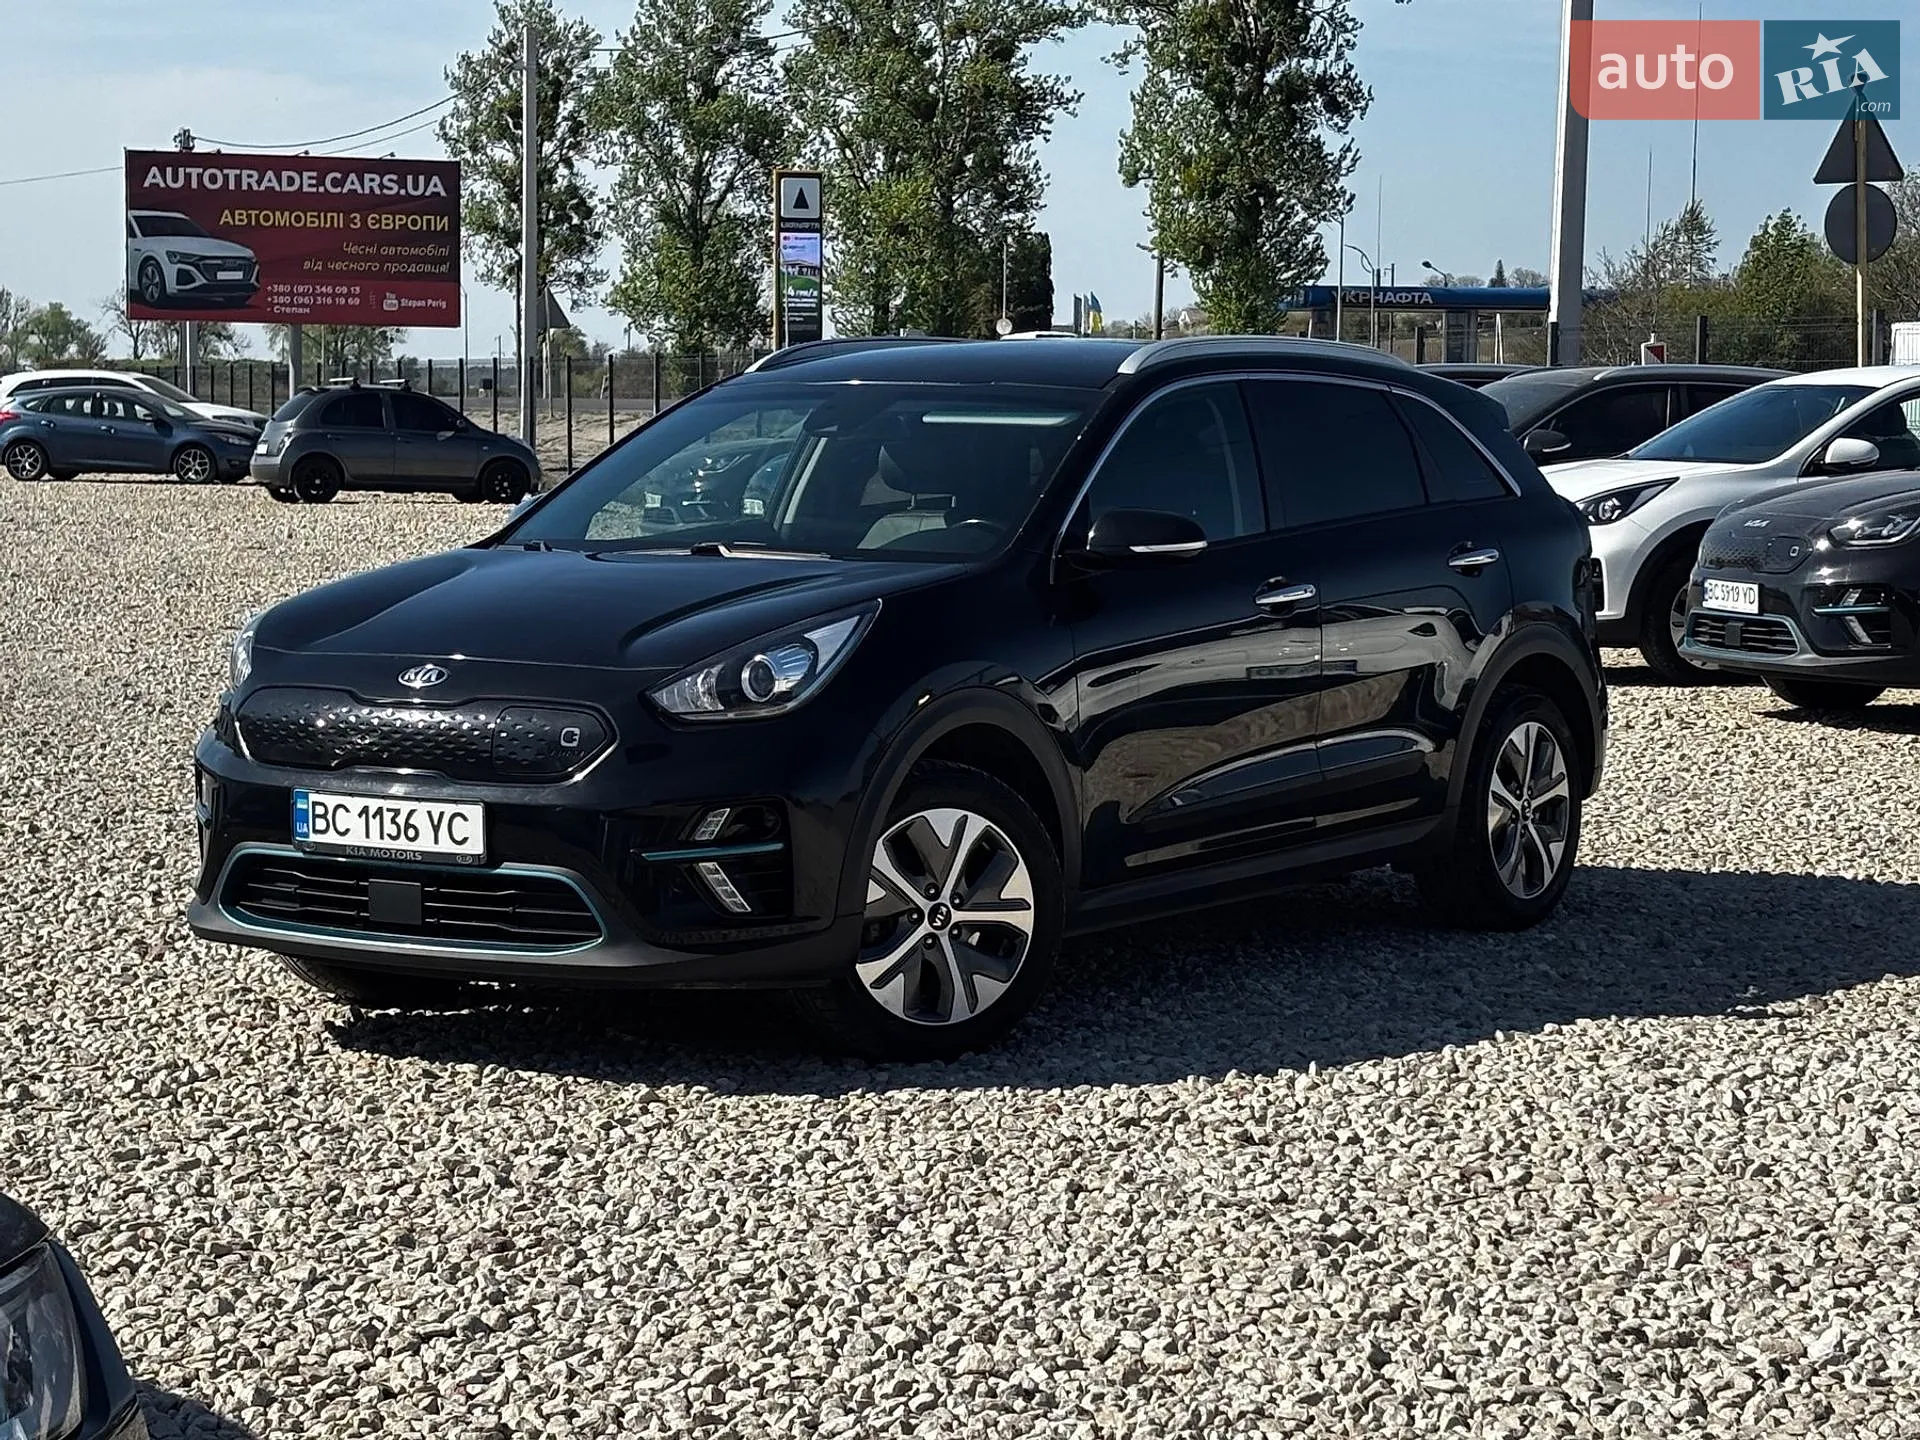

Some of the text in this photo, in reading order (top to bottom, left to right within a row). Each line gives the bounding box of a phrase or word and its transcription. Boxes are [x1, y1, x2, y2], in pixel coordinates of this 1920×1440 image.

[143, 166, 447, 197] AUTOTRADE.CARS.UA
[219, 209, 344, 228] АВТОМОБІЛІ
[367, 213, 449, 231] ЄВРОПИ
[343, 241, 450, 257] Чесні автомобілі
[303, 258, 450, 274] від чесного продавця!
[266, 283, 291, 294] +380
[266, 295, 291, 304] +380
[400, 298, 426, 309] Stepan
[1331, 289, 1434, 305] УКРНАФТА
[273, 305, 311, 314] Степан
[1742, 585, 1756, 605] YD
[296, 821, 309, 834] UA
[311, 801, 470, 846] BC 1136 YC
[345, 846, 423, 861] KIA MOTORS
